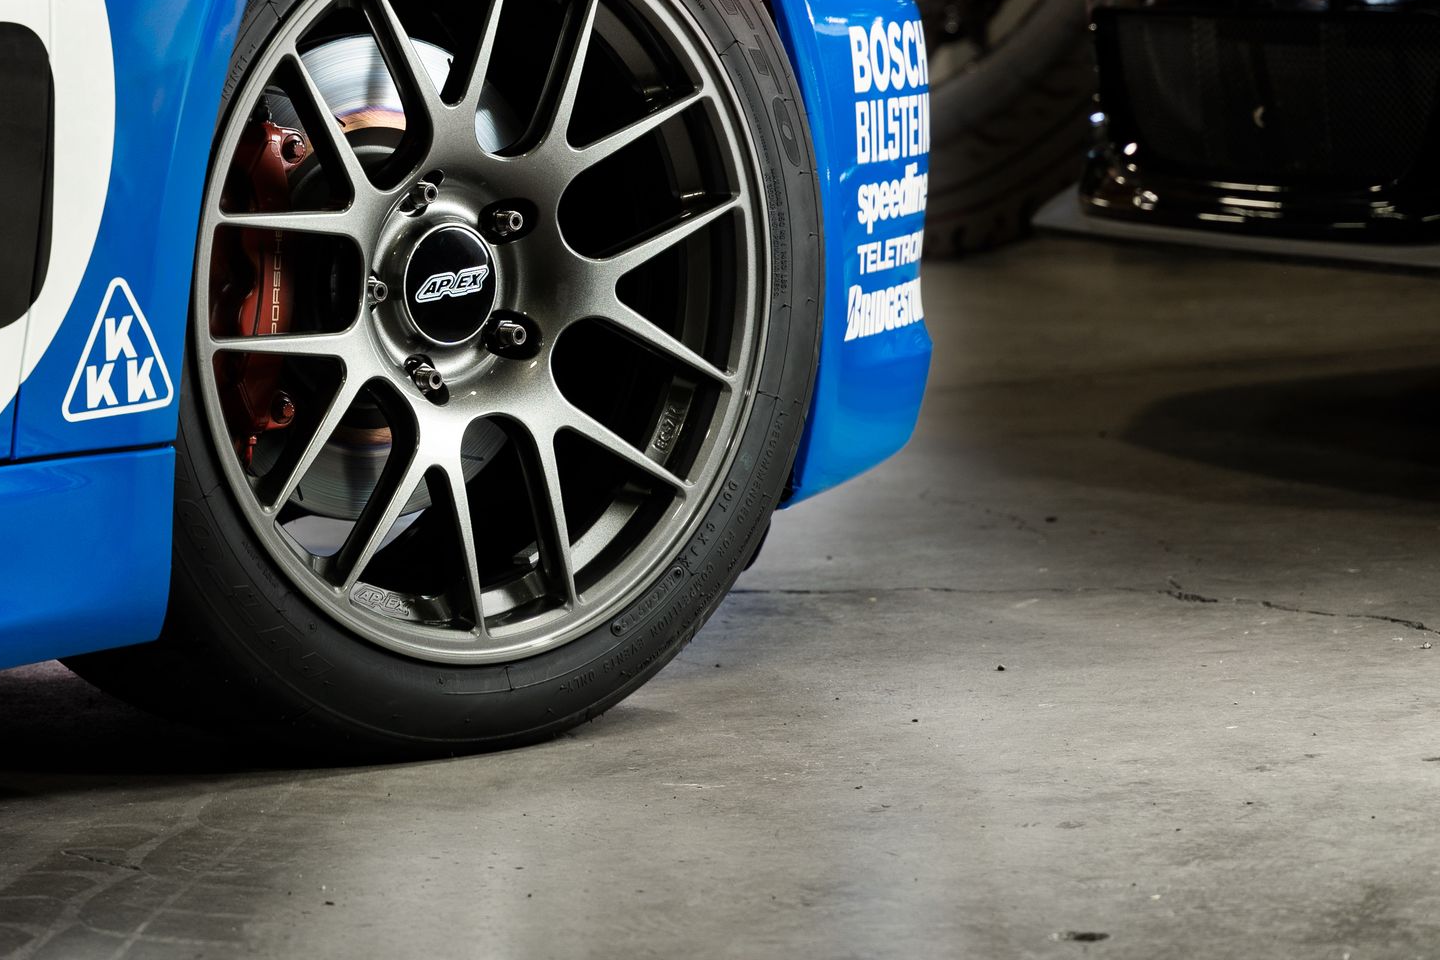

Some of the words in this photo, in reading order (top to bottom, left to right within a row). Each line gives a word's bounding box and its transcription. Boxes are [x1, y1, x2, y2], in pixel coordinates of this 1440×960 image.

[848, 20, 929, 94] BOSCH
[855, 92, 930, 165] BILSTEIN
[418, 267, 486, 299] APEX
[716, 478, 738, 513] DOT
